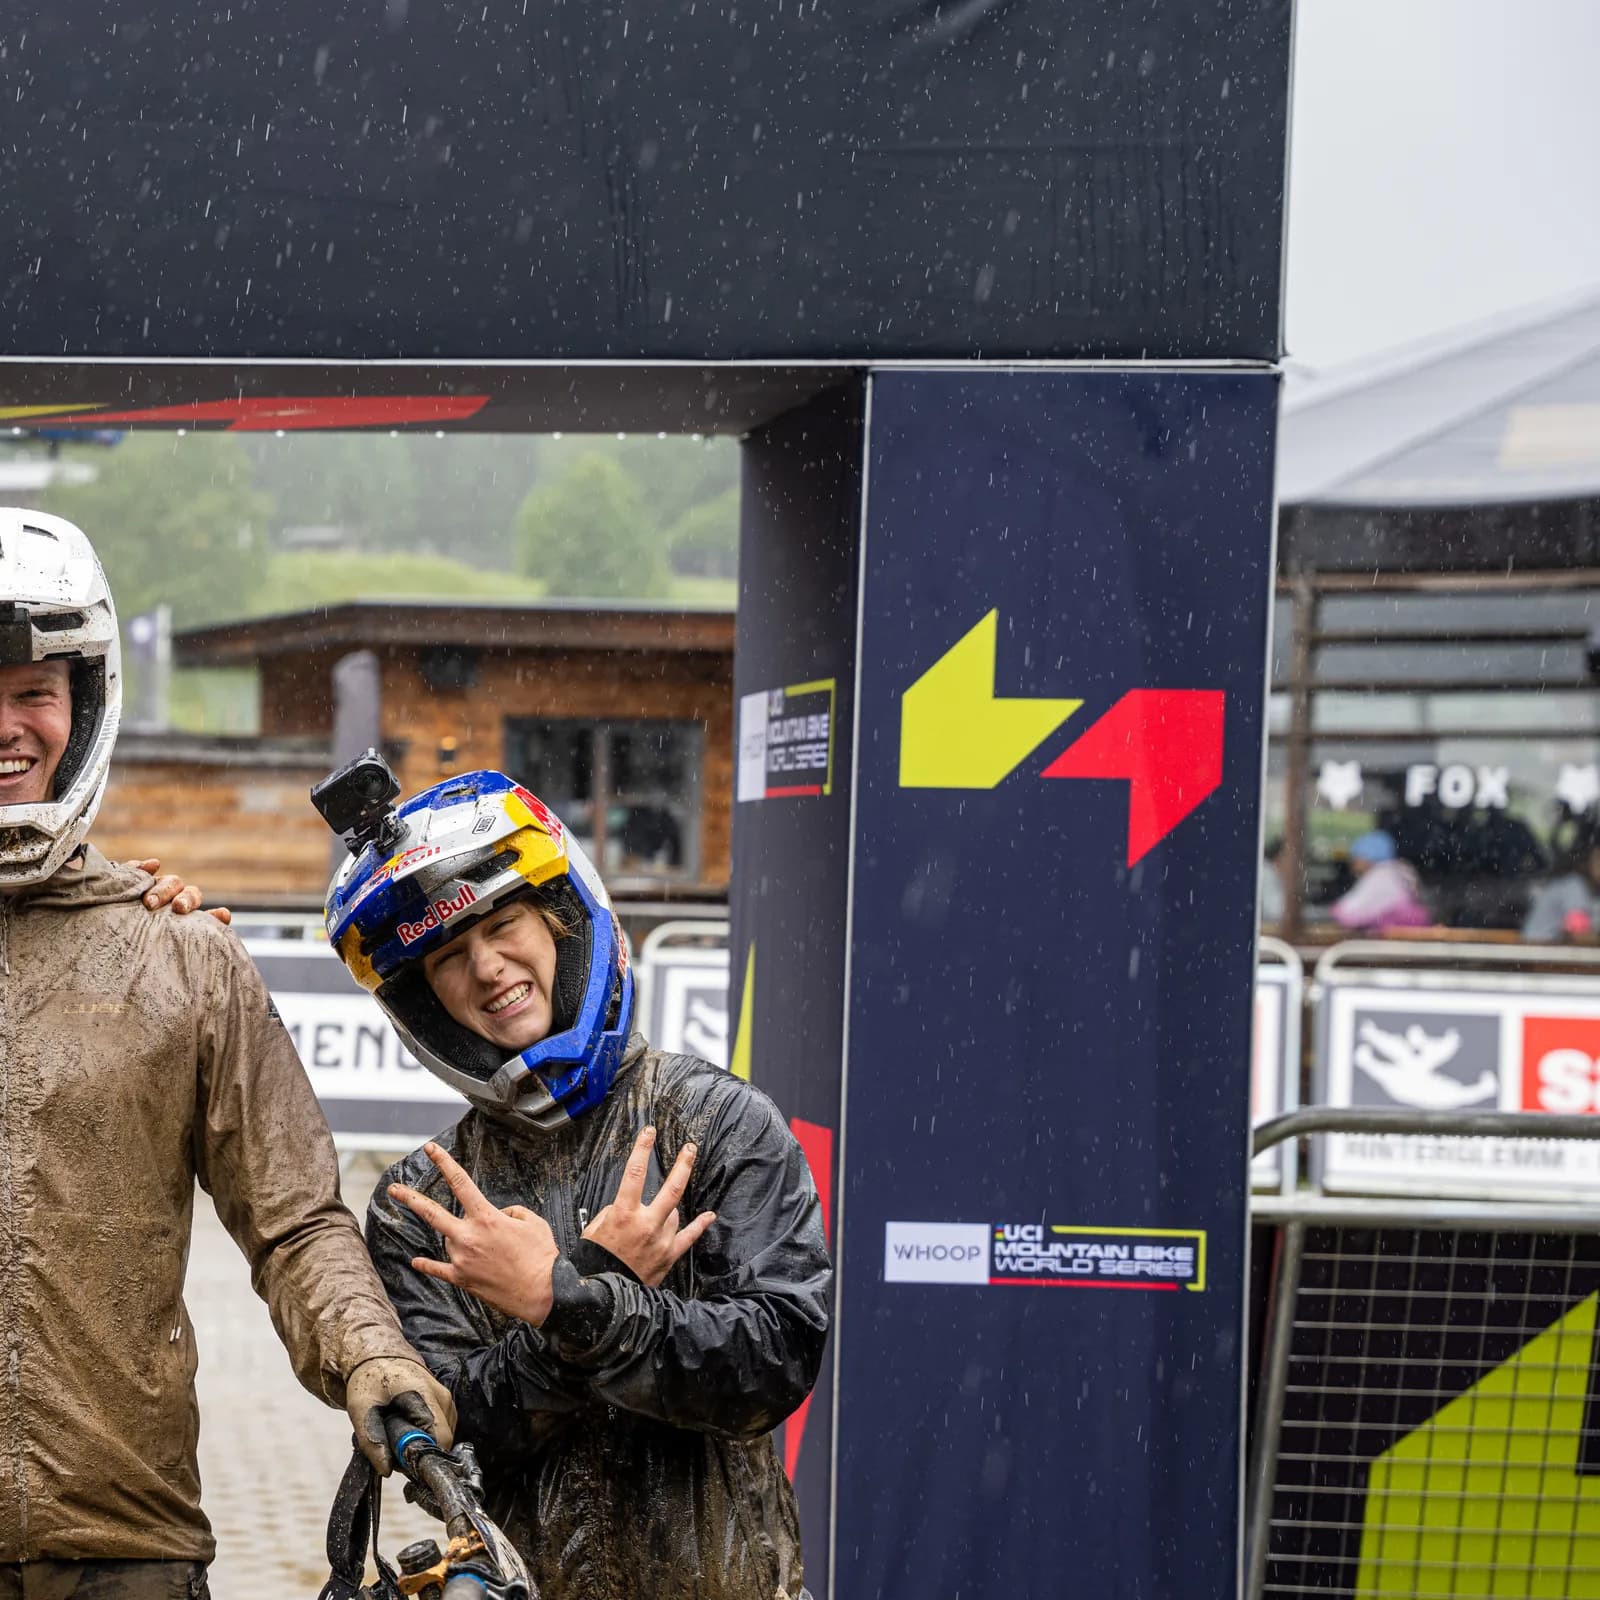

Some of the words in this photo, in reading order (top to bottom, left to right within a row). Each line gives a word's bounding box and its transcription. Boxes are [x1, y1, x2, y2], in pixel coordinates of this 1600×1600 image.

[1405, 764, 1509, 809] FOX
[397, 905, 439, 947] Red
[433, 883, 477, 922] Bull
[1004, 1224, 1043, 1241] UCI
[893, 1244, 981, 1261] WHOOP
[995, 1243, 1129, 1260] MOUNTAIN
[1134, 1246, 1193, 1261] BIKE
[995, 1257, 1094, 1273] WORLD
[1099, 1260, 1193, 1277] SERIES
